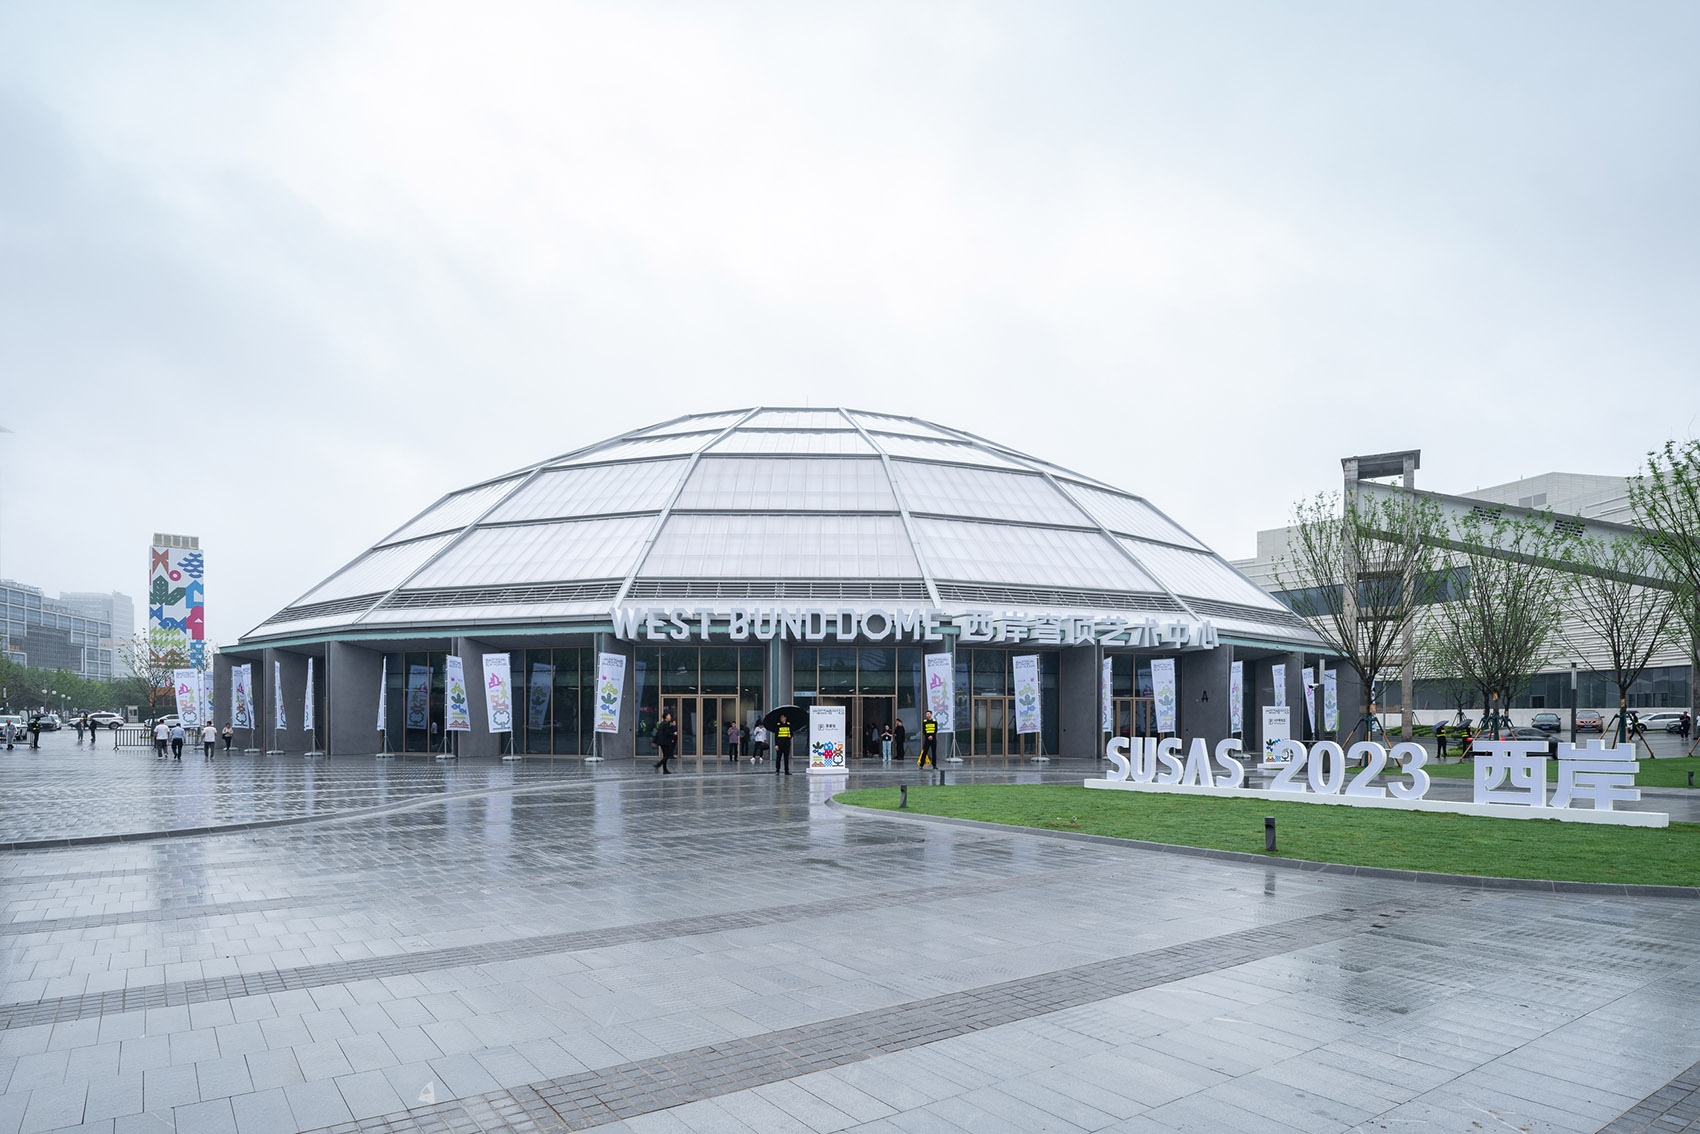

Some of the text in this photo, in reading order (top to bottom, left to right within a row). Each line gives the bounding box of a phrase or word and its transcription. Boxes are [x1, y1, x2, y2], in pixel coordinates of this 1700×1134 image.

[611, 607, 943, 643] WEST BUND DOME
[964, 609, 1220, 650] 西岸穹顶艺术中心
[1201, 690, 1209, 702] A
[1106, 736, 1642, 812] SUSAS 2023 西岸
